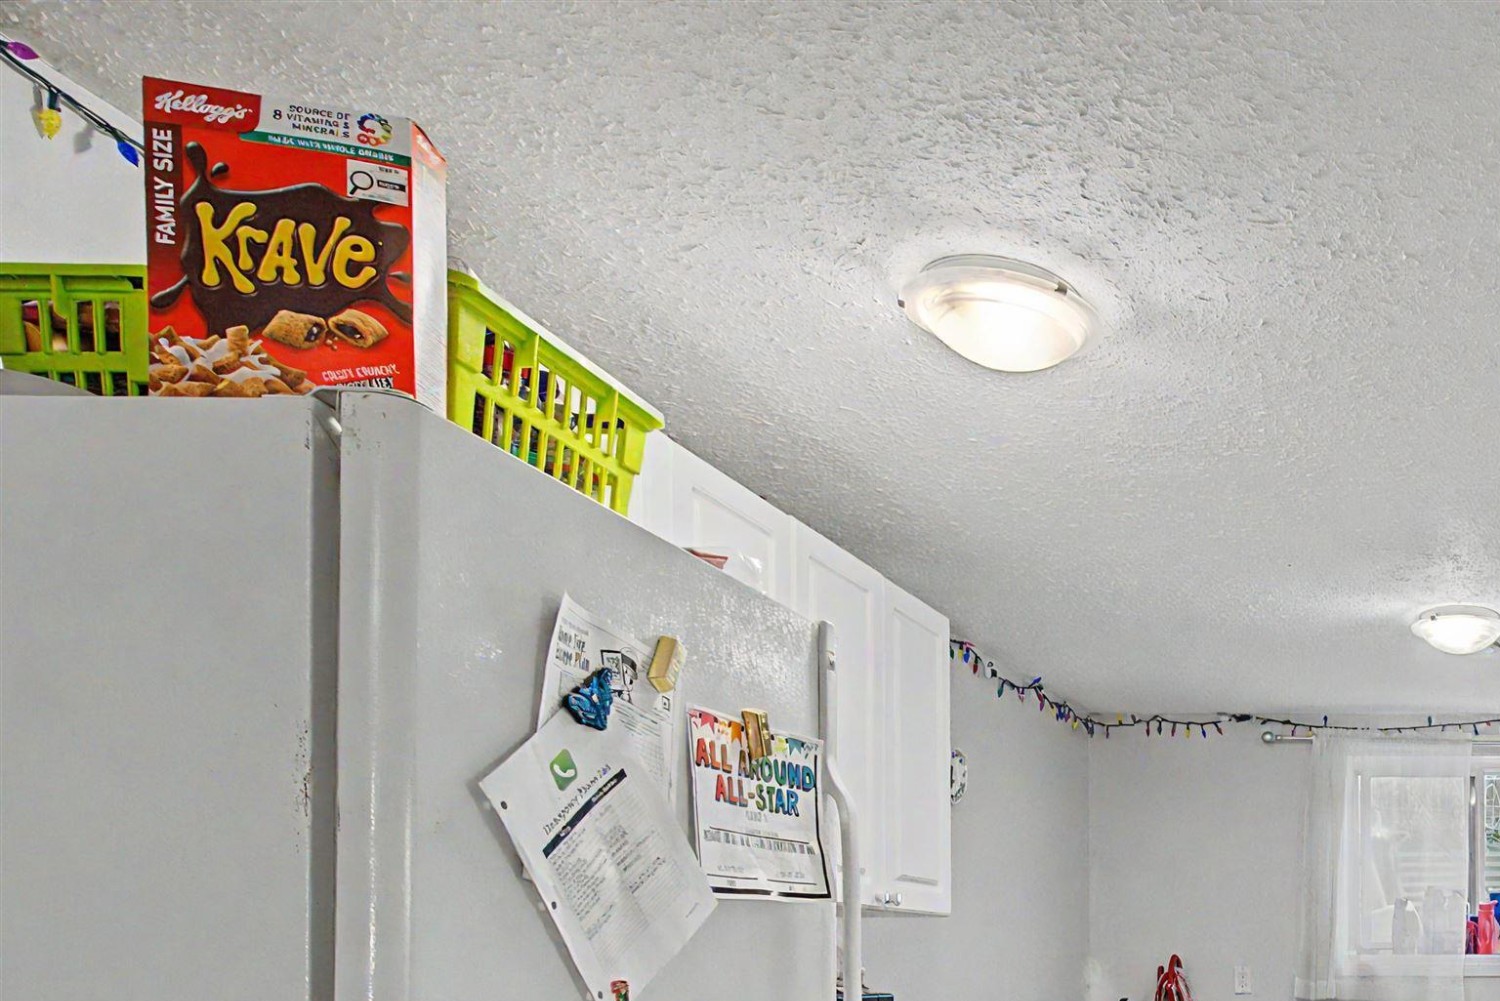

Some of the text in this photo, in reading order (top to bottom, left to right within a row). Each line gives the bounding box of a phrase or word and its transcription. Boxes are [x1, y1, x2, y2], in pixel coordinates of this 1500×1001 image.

[154, 90, 249, 123] Kellogg's
[272, 109, 282, 120] 8
[289, 105, 333, 118] SOURCE
[152, 128, 176, 244] FAMILY SIZE
[695, 738, 733, 774] ALL
[715, 774, 800, 817] ALL-STAR
